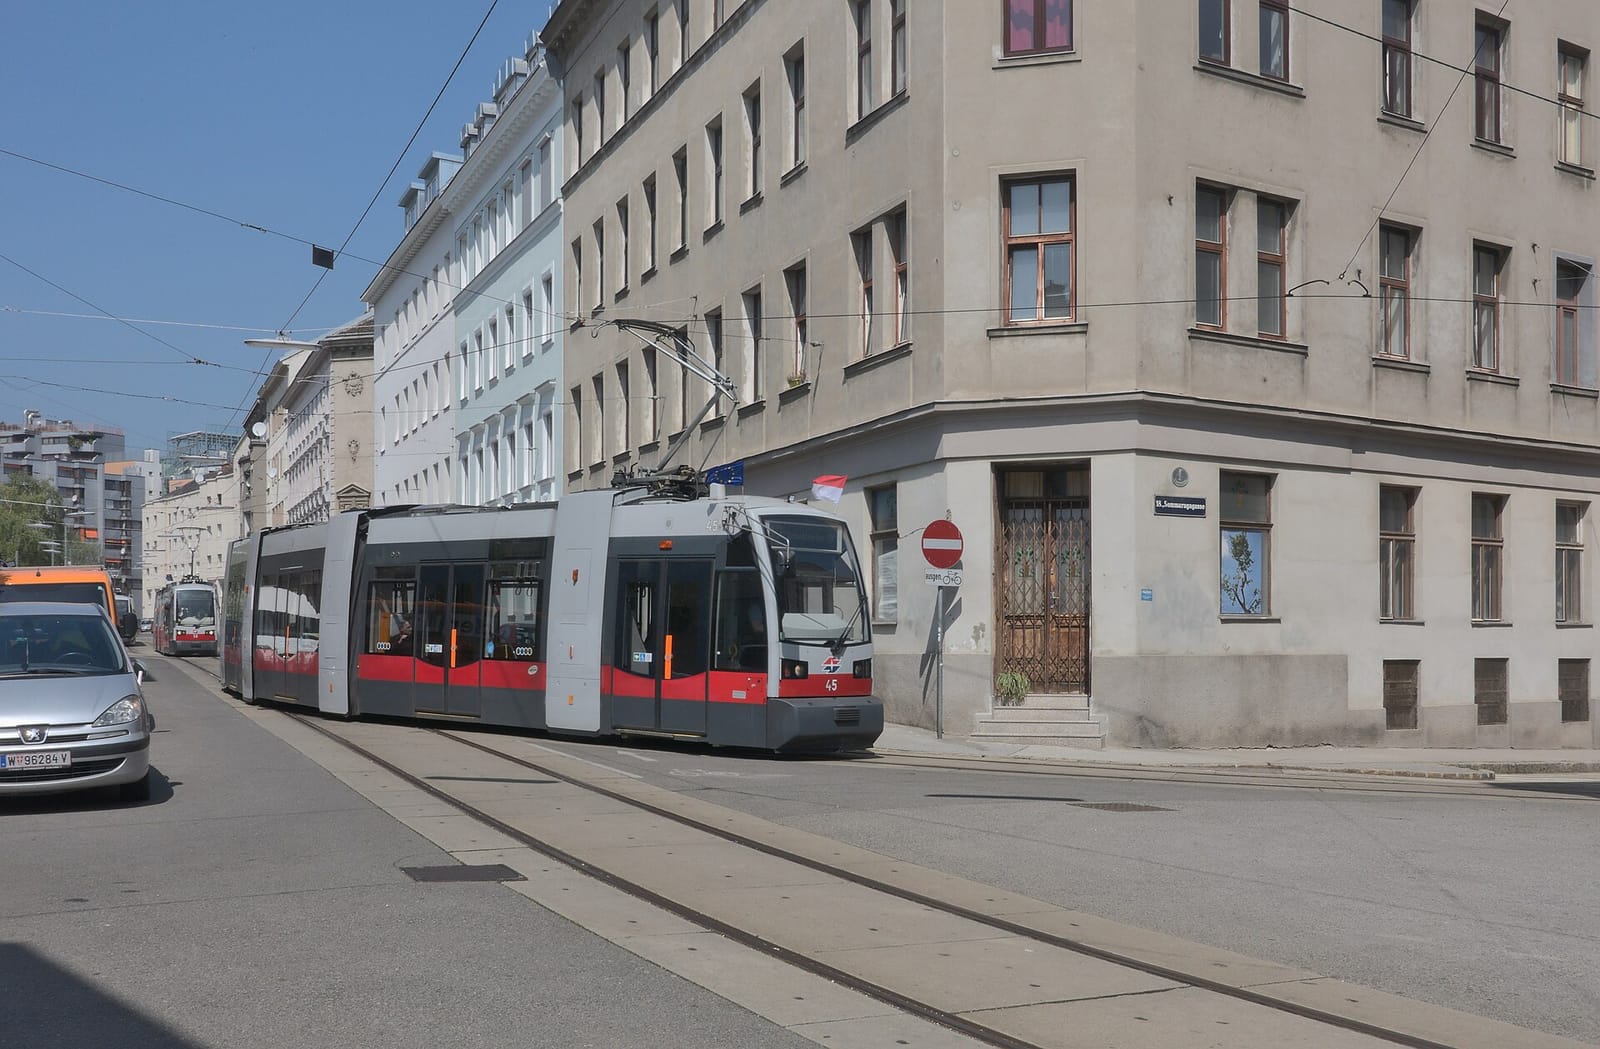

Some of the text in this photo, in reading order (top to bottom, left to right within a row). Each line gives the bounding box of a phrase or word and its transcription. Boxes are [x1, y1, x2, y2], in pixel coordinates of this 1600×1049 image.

[825, 679, 838, 692] 45
[8, 753, 67, 766] W 96284 V
